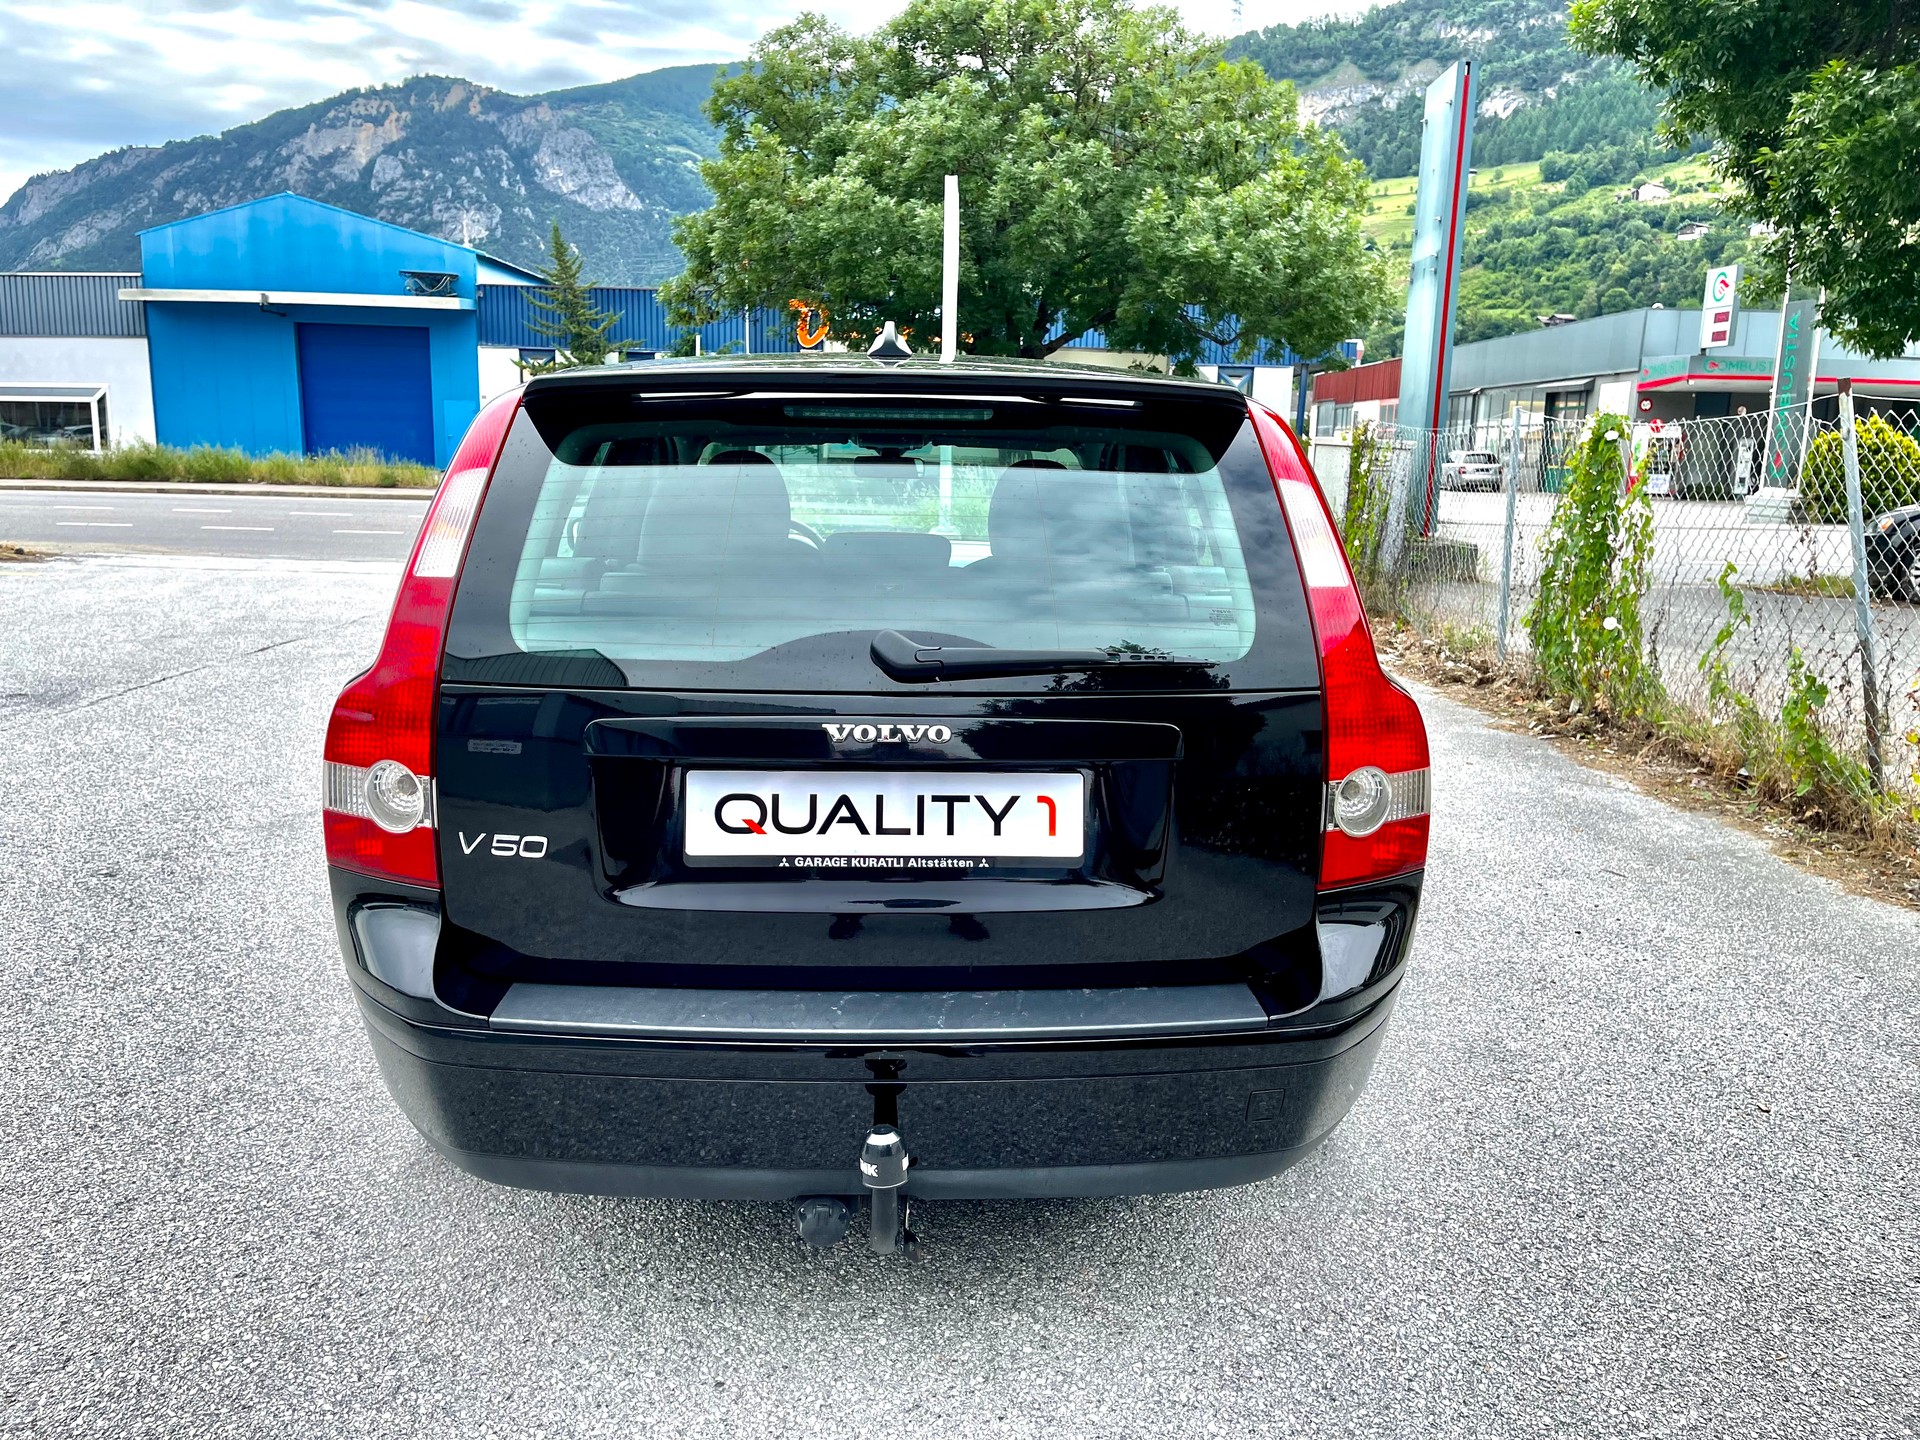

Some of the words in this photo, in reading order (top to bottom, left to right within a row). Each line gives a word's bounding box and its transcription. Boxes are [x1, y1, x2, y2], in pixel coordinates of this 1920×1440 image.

[1702, 358, 1774, 373] COMBUST
[821, 723, 952, 744] VOLVO
[714, 793, 1021, 837] QUALITY
[1036, 795, 1057, 837] 1
[794, 856, 848, 868] GARAGE
[851, 857, 904, 868] KURATLI
[907, 857, 974, 868] Altstätten
